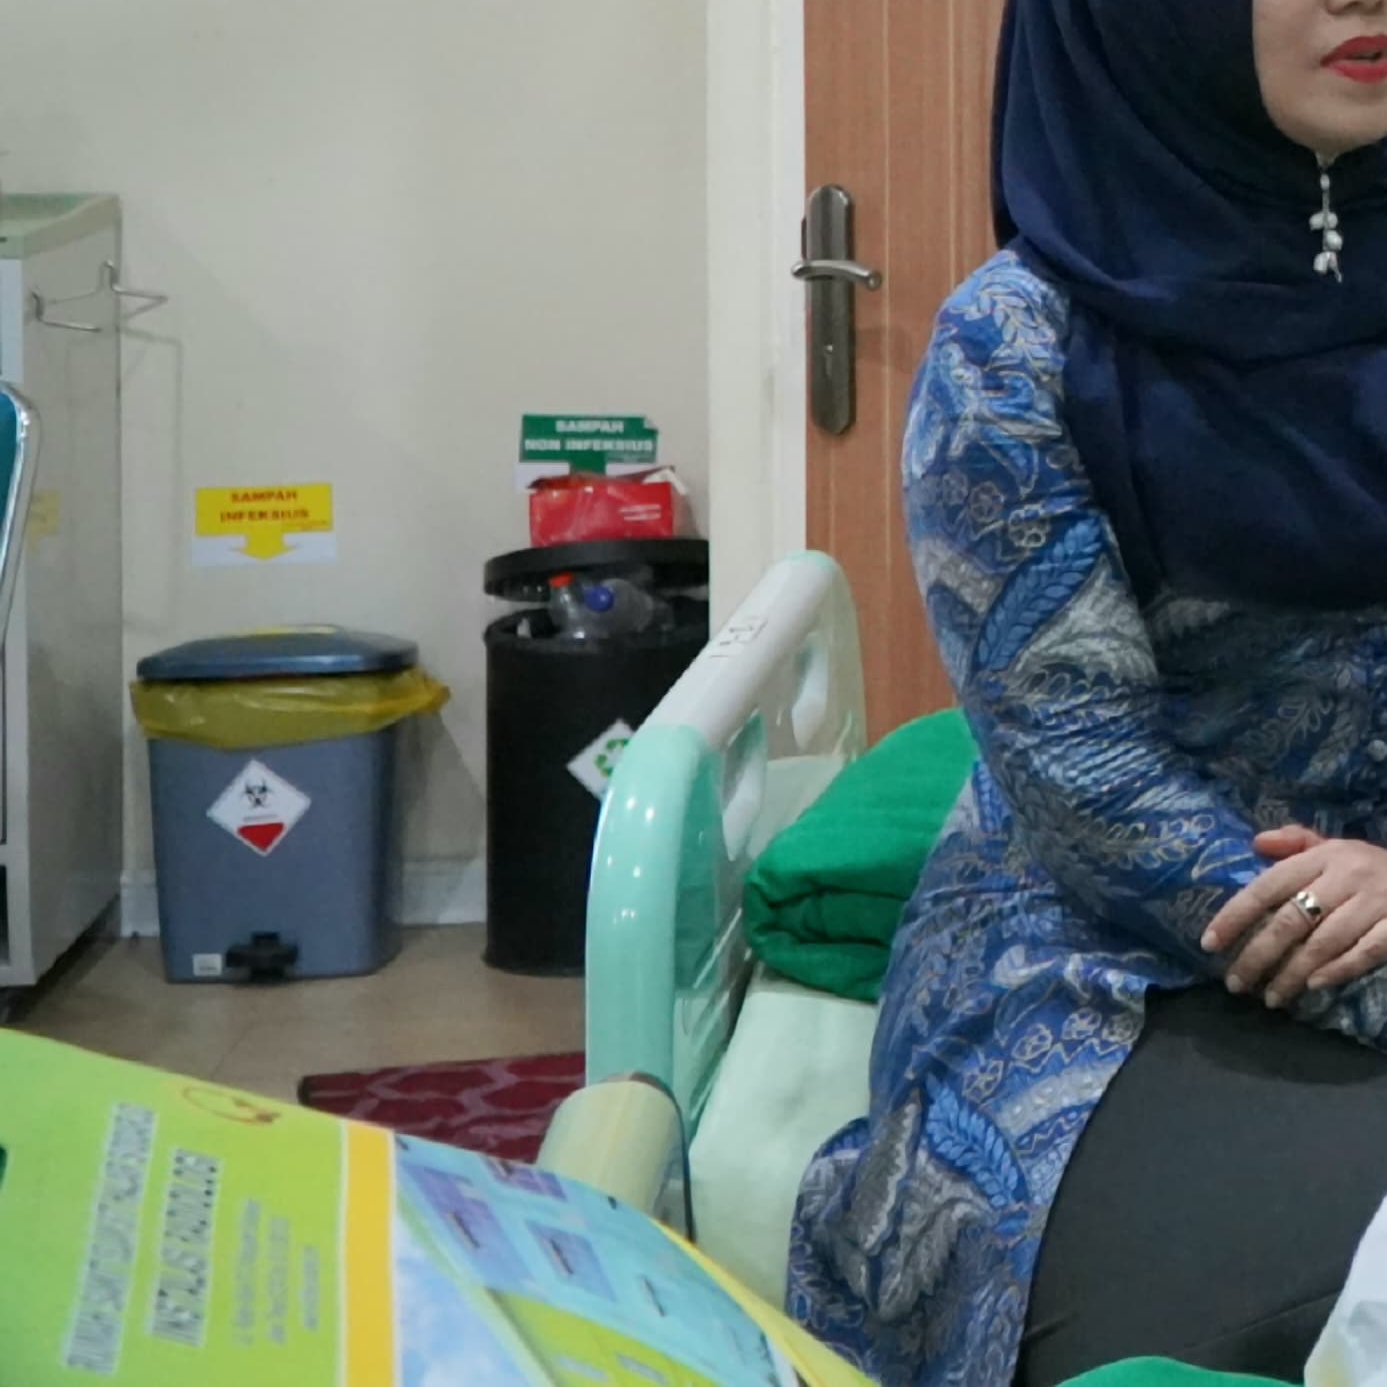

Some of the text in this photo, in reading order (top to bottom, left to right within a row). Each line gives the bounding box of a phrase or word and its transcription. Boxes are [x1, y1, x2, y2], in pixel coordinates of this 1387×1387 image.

[555, 419, 625, 433] SAMPAH
[524, 438, 561, 451] NON
[230, 490, 298, 503] SAMPAH
[219, 508, 310, 523] INFEKSIUS
